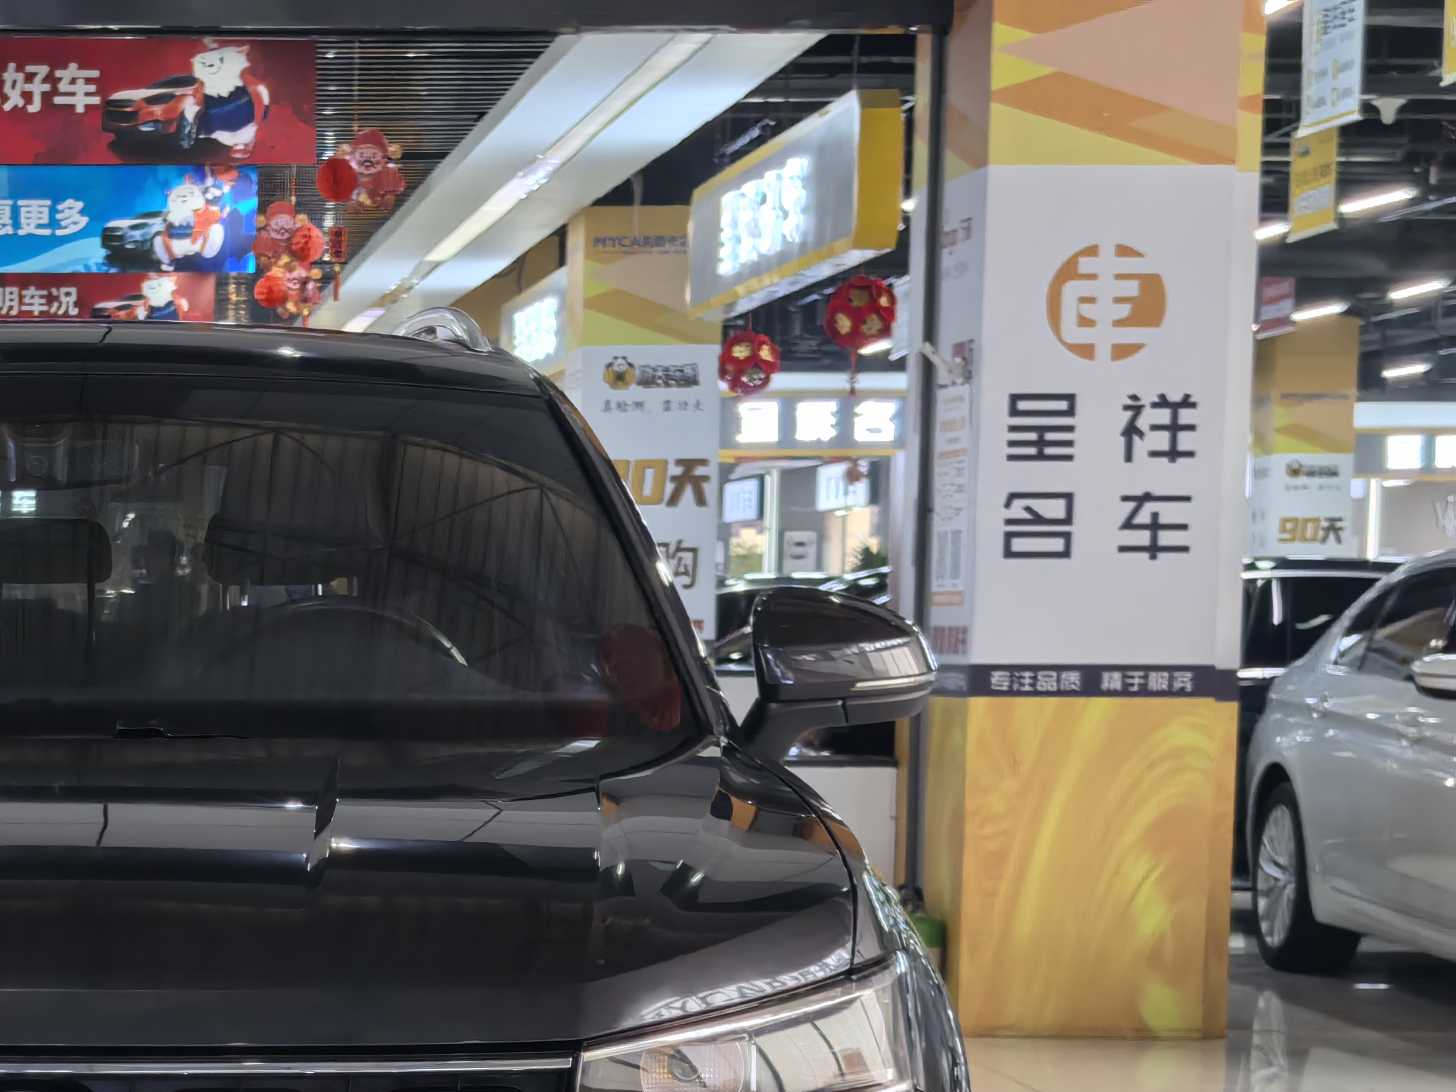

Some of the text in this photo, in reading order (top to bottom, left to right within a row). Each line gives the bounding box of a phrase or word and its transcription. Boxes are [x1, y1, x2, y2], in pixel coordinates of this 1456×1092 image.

[1006, 392, 1199, 464] 呈祥
[1003, 491, 1192, 560] 名车
[1277, 517, 1345, 544] 90天
[990, 670, 1081, 692] 专注品质
[1100, 670, 1193, 692] 精于服务
